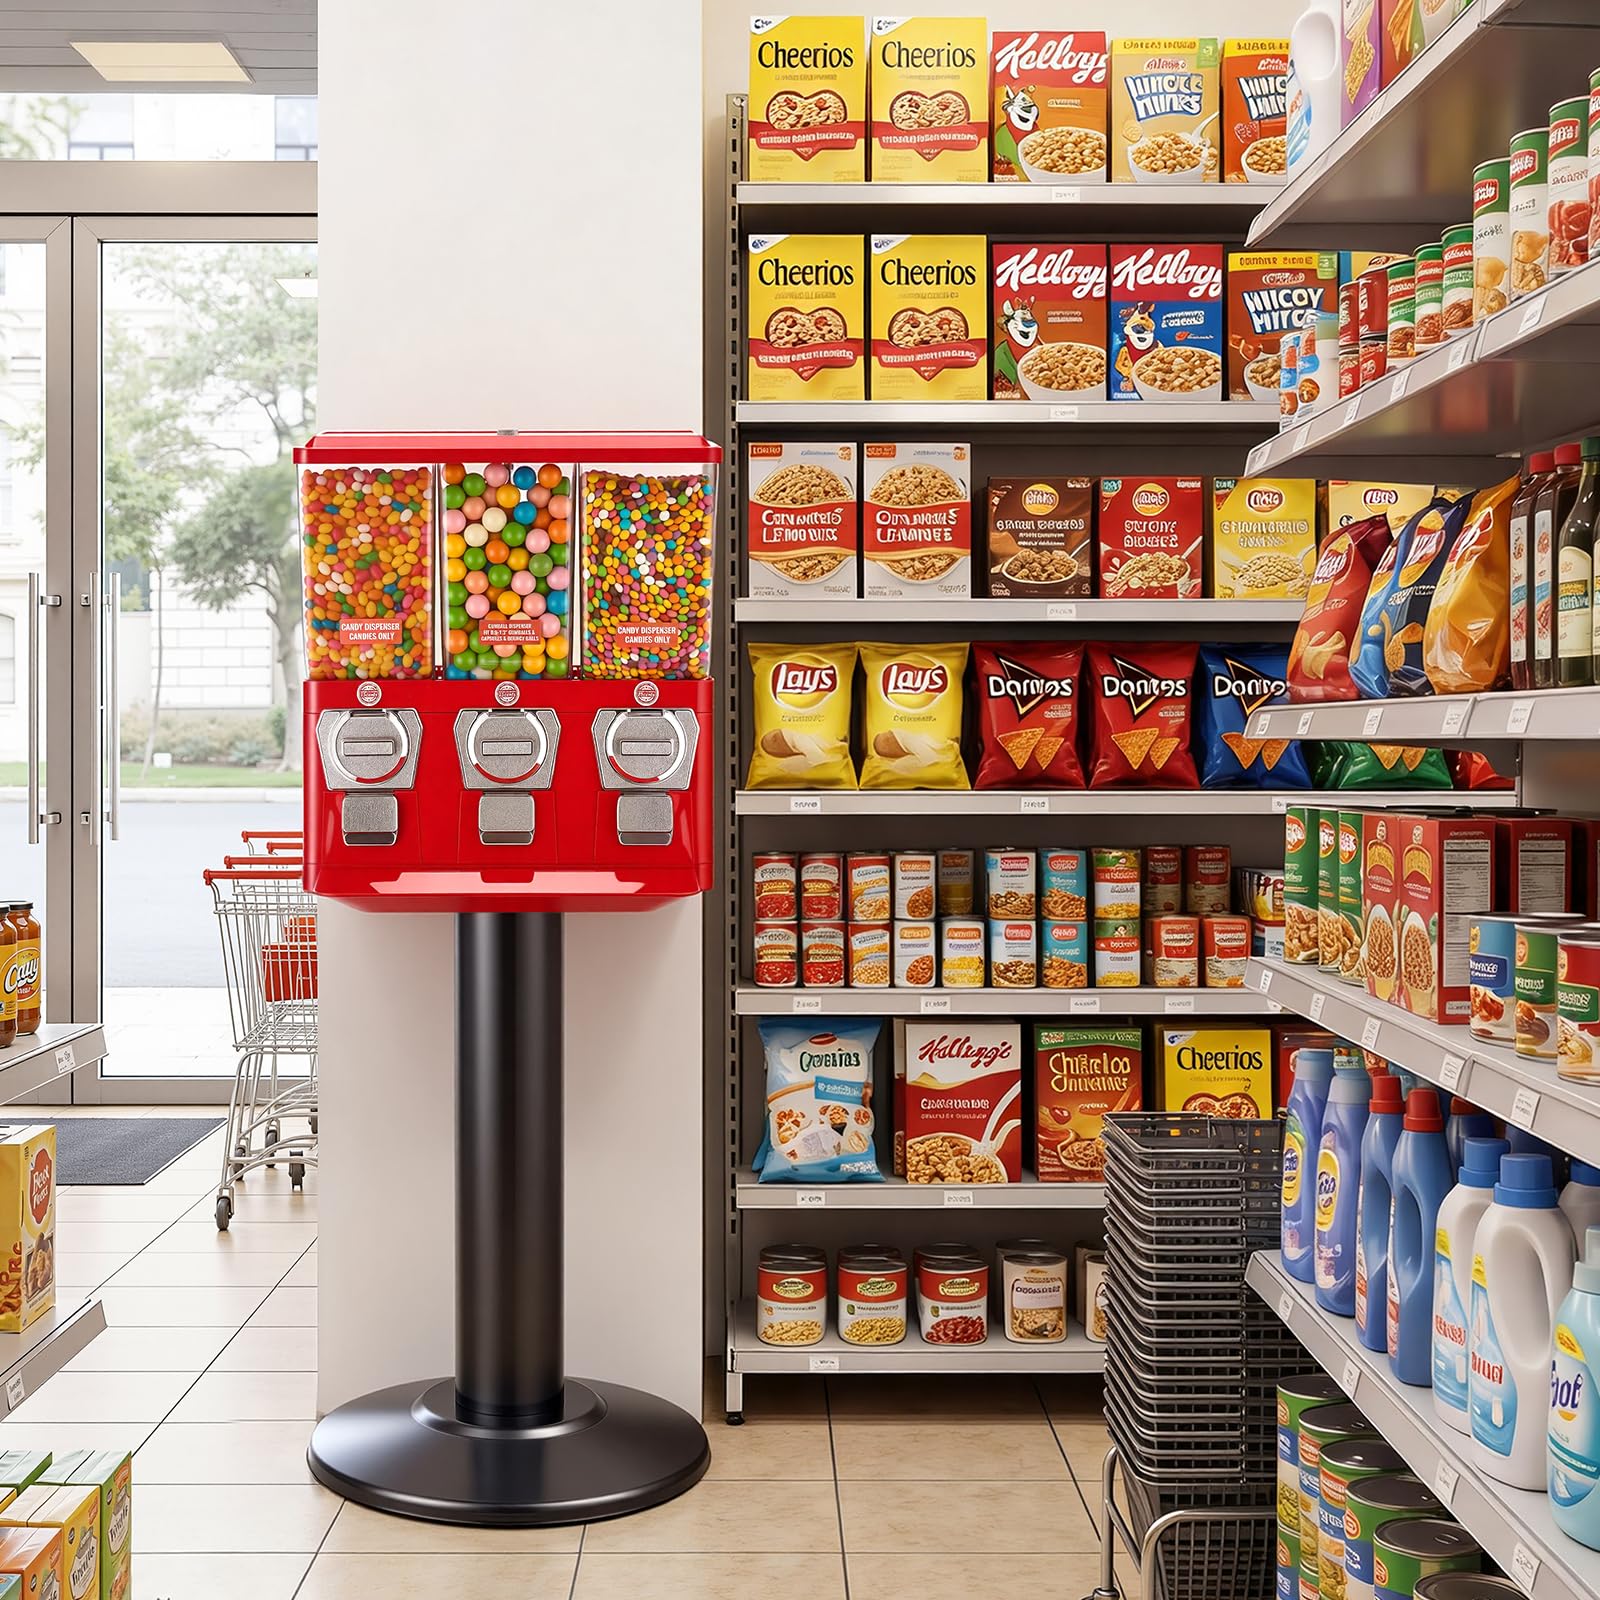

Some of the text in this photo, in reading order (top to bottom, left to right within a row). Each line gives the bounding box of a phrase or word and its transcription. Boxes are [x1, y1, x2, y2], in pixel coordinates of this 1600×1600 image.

[758, 41, 854, 69] Cheerios
[881, 42, 976, 69] Cheerios
[758, 259, 854, 286] Cheerios
[881, 260, 976, 286] Cheerios
[341, 622, 400, 631] CANDY DISPENSER
[349, 632, 395, 640] CANDIES ONLY
[1177, 1045, 1263, 1070] Cheerios
